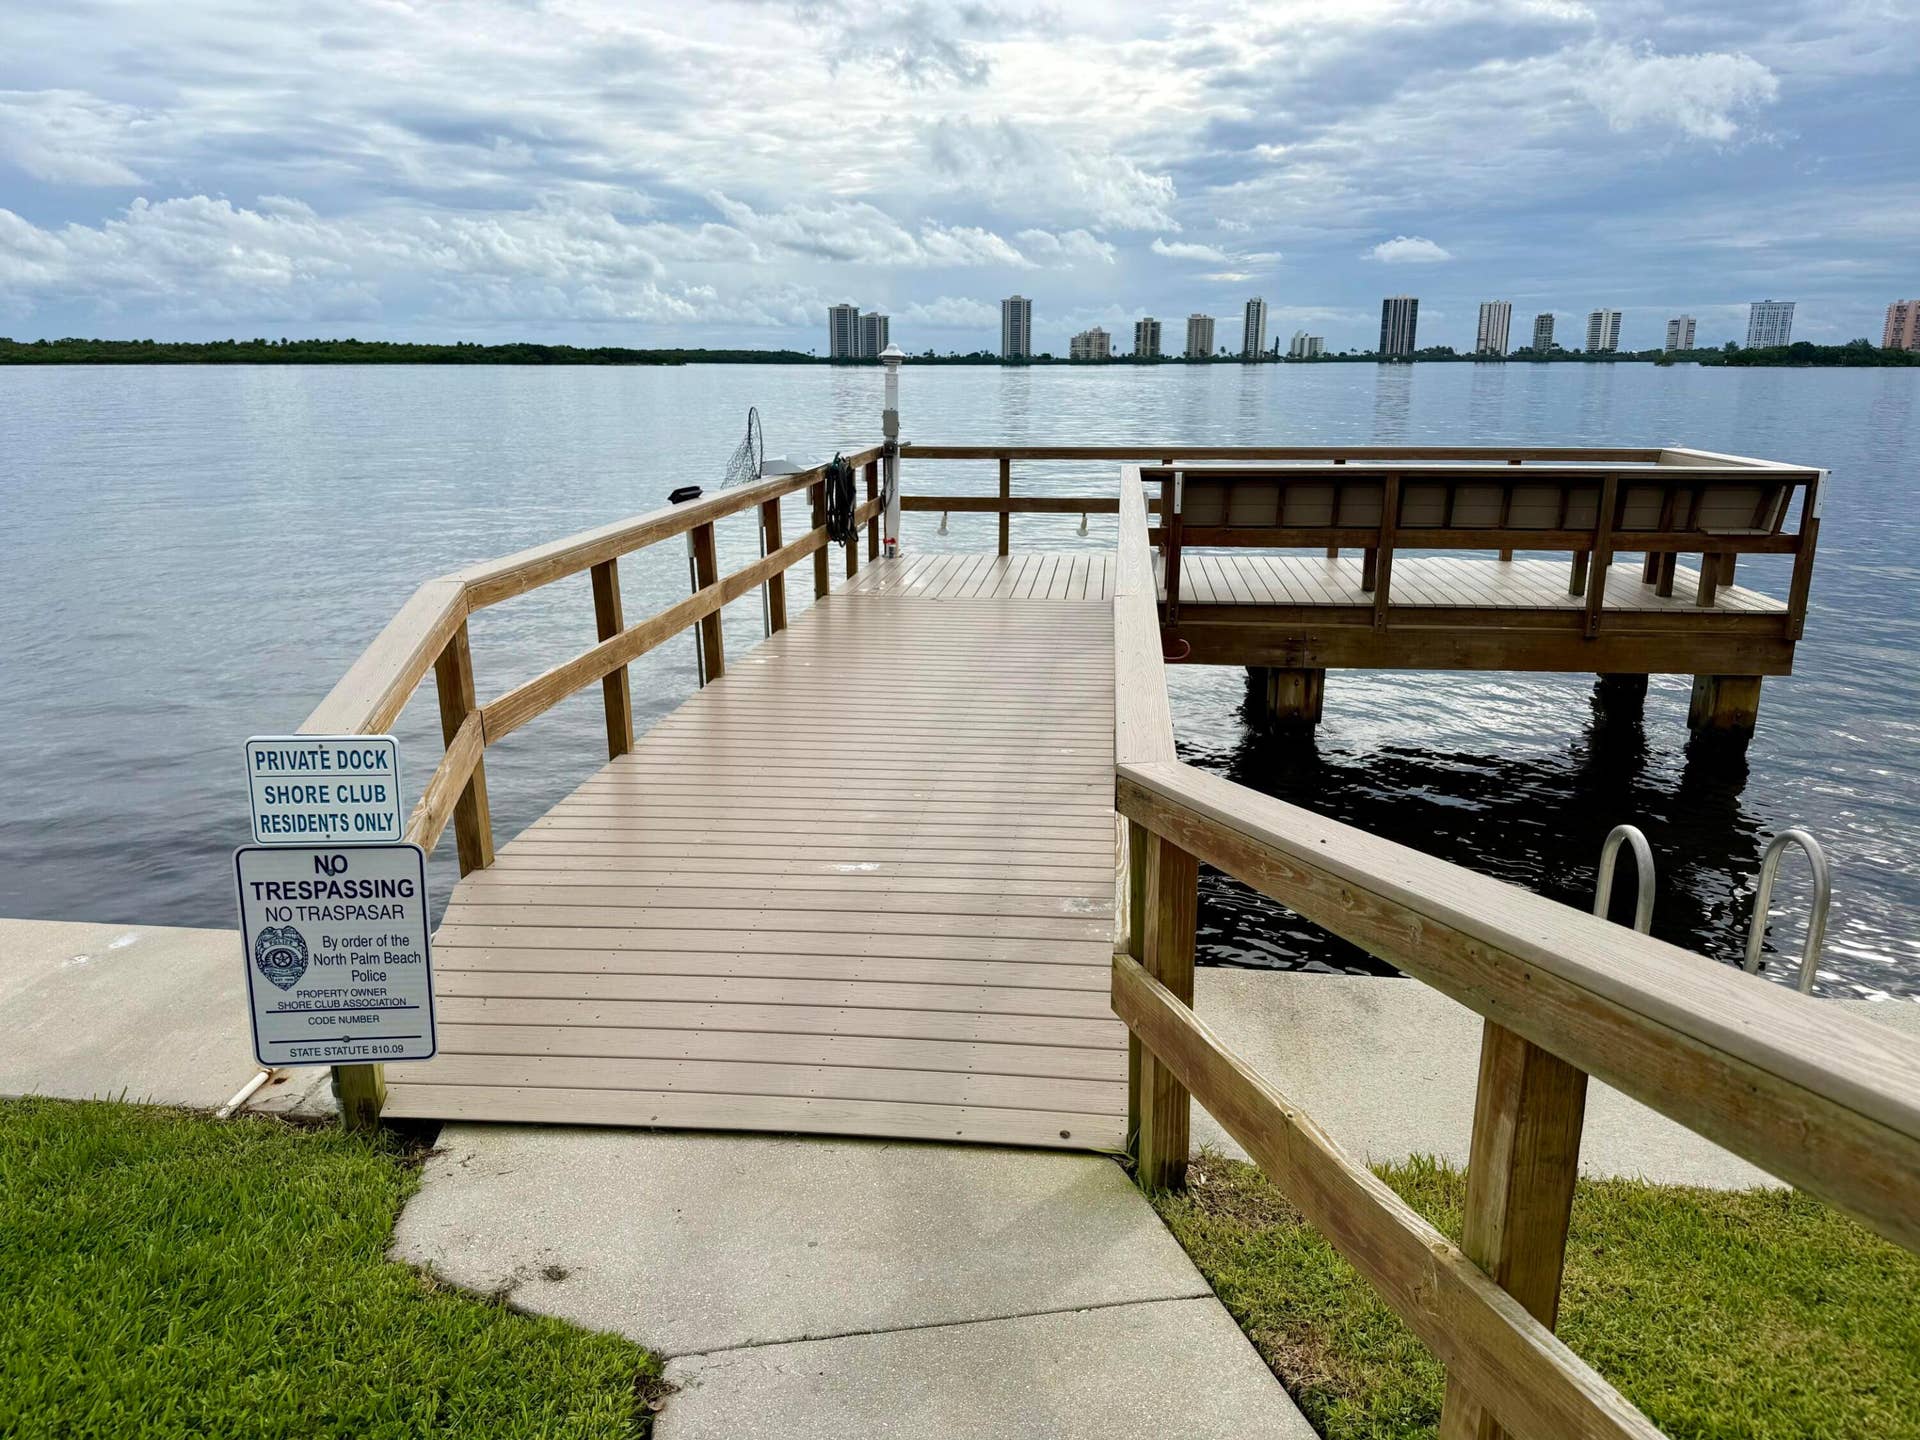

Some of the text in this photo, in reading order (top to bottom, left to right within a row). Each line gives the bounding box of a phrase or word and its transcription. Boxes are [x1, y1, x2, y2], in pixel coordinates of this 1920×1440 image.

[255, 750, 388, 771] PRIVATE DOCK
[264, 784, 386, 804] SHORE CLUB
[260, 812, 393, 833] RESIDENTS ONLY
[314, 854, 348, 874] NO
[250, 879, 414, 900] TRESPASSING
[265, 904, 404, 922] NO TRASPASAR
[322, 934, 410, 951] By order of the
[313, 951, 421, 966] North Palm Beach
[351, 969, 387, 982] Police
[296, 988, 387, 999] PROPERTY OWNER
[278, 998, 406, 1010] SHORE CLUB ASSOCIATION
[308, 1015, 380, 1025] CODE NUMBER
[290, 1044, 404, 1057] STATE STATUTE 810.09
